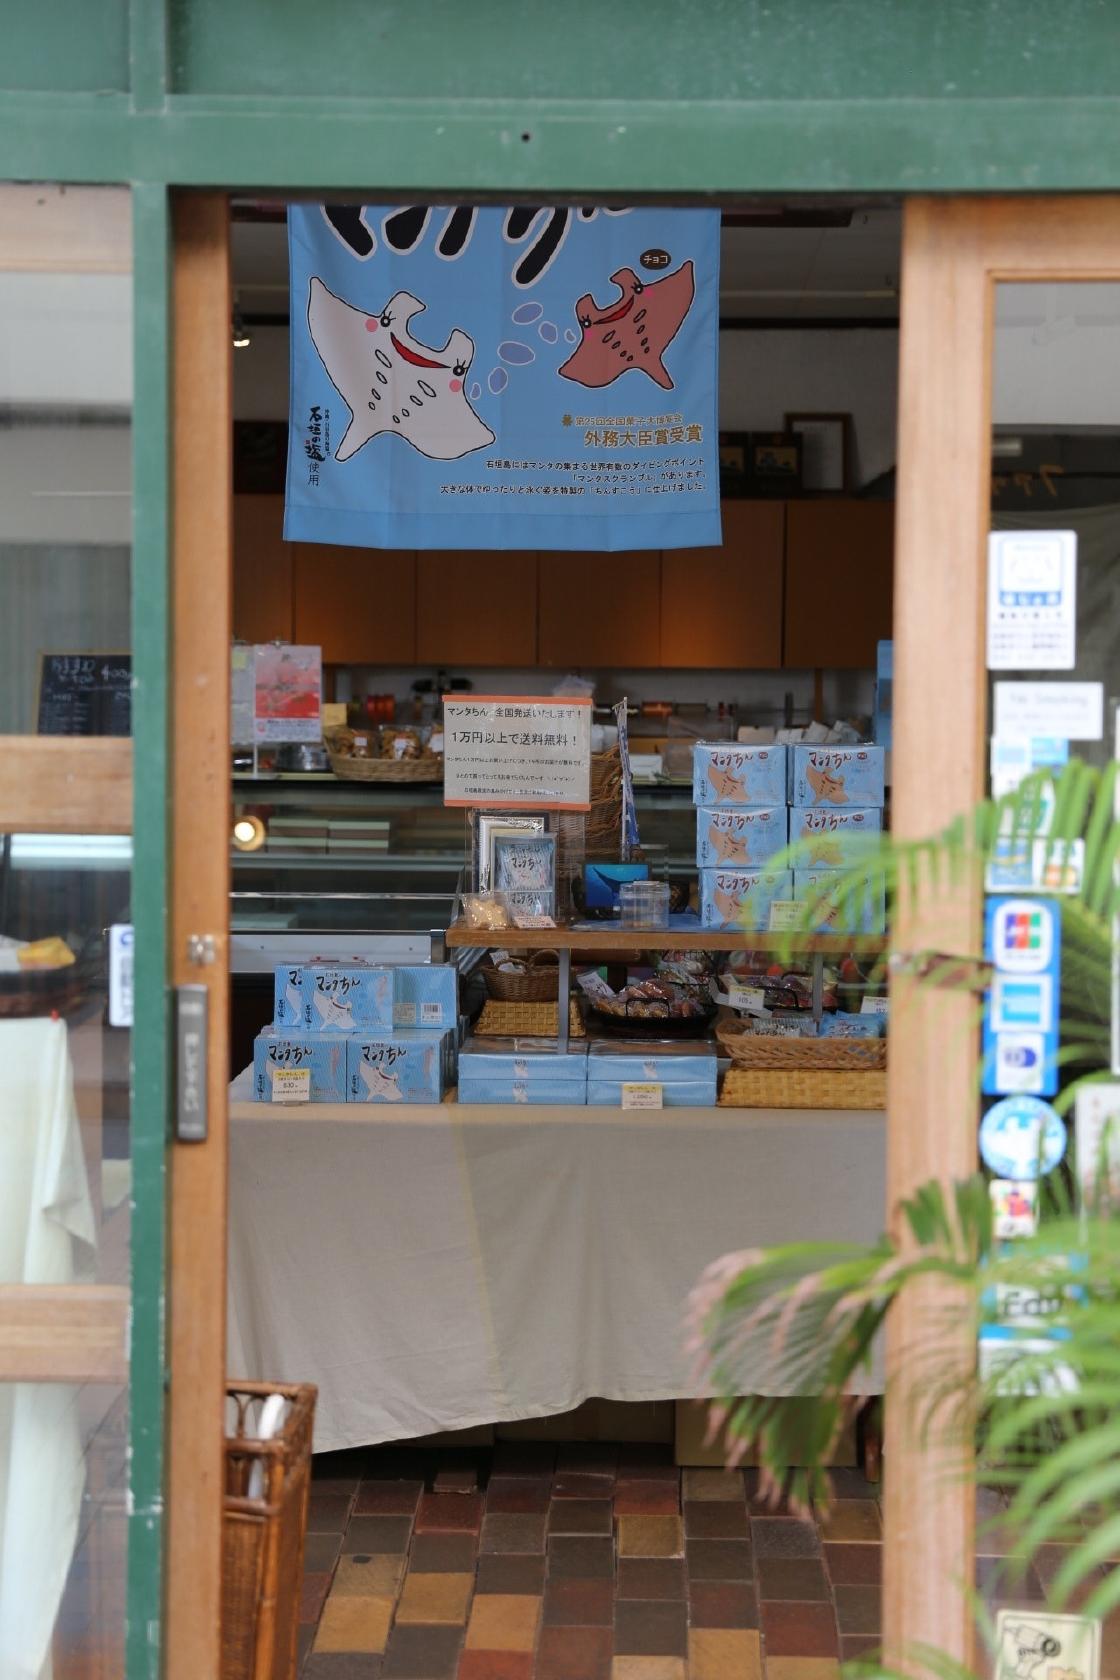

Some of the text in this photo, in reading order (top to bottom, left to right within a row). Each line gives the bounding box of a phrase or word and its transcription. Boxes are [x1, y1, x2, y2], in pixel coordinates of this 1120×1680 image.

[643, 255, 668, 265] チョコ
[584, 424, 703, 447] 外務大臣賞受賞
[486, 457, 705, 471] 石垣島にはマンタの集まる世界有数のダイビングポイント
[315, 975, 361, 996] マンタちん
[268, 1045, 313, 1065] マンタちん
[361, 1045, 407, 1065] マンタちん
